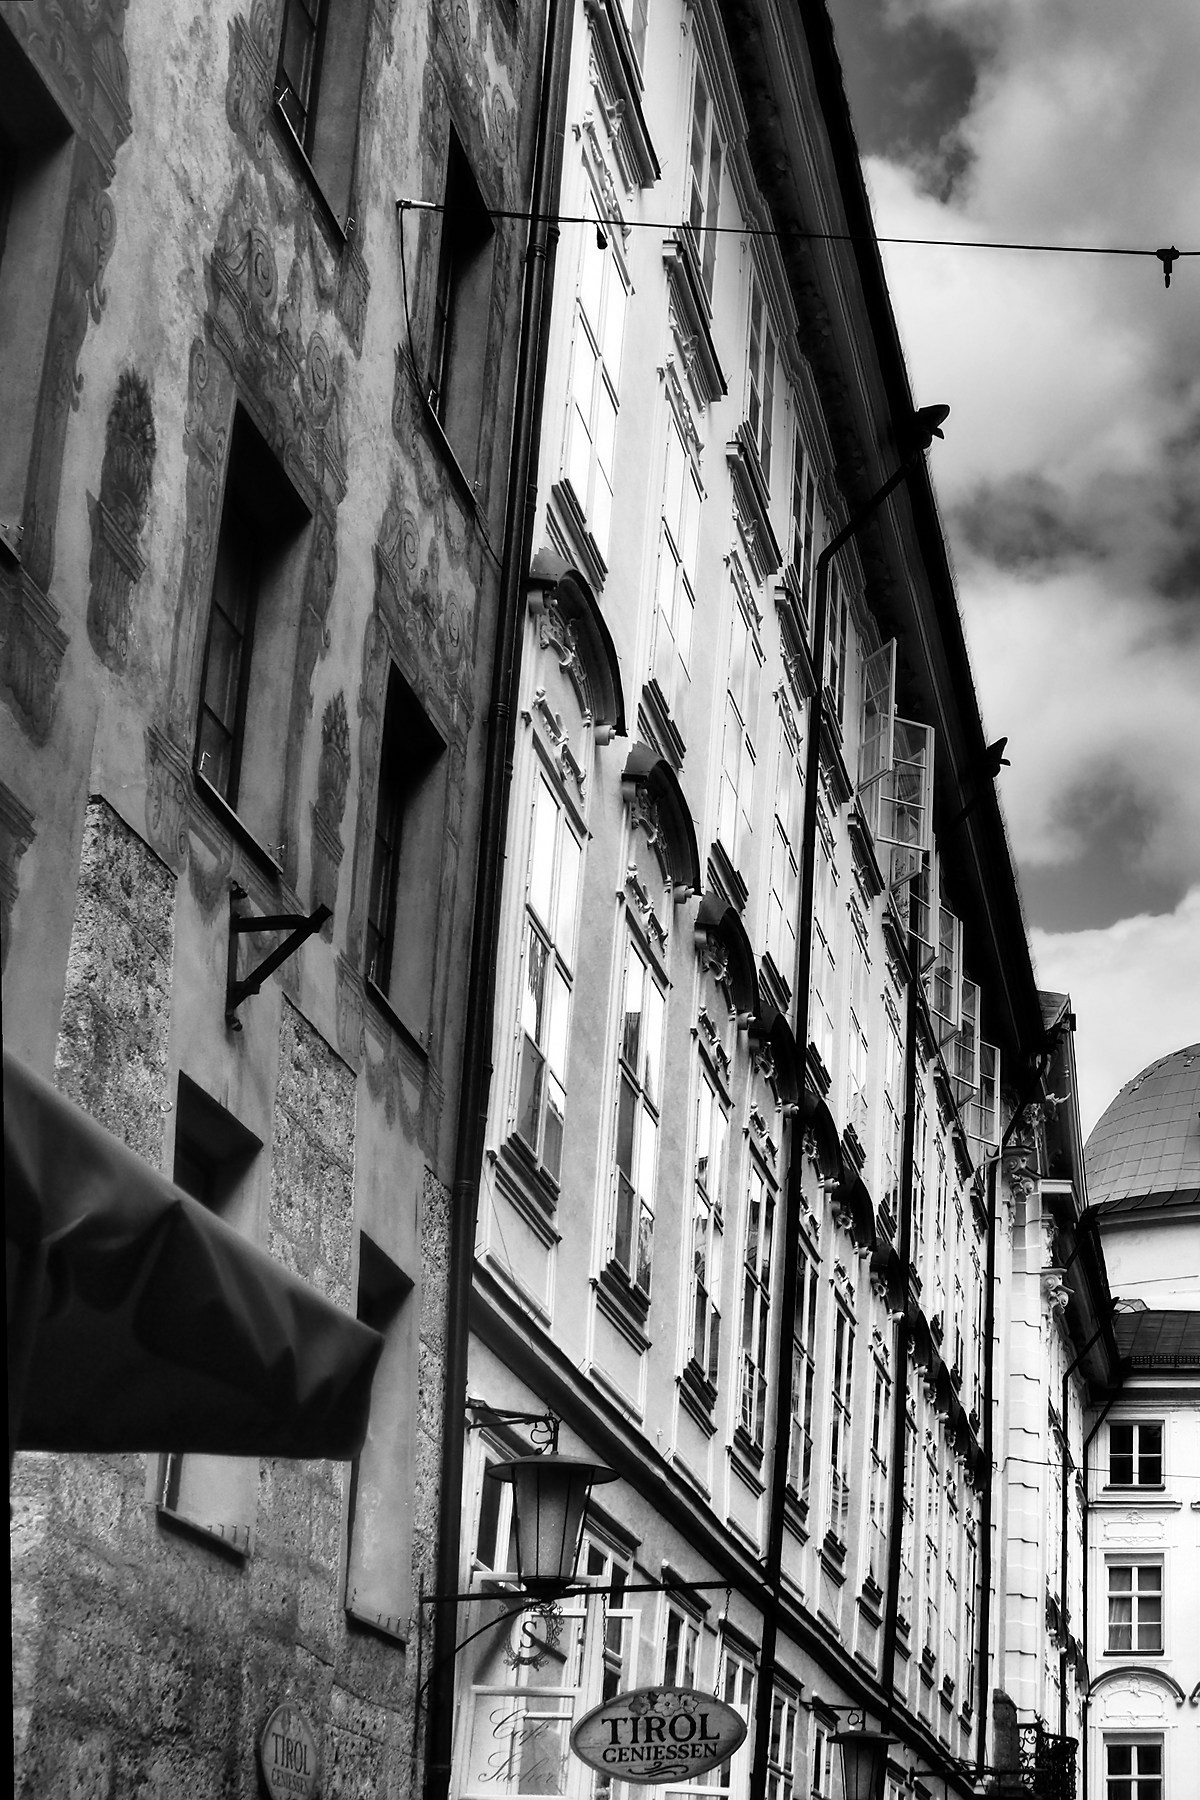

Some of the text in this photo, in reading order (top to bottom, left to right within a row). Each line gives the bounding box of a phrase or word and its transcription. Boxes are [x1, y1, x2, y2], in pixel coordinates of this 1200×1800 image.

[519, 1620, 538, 1649] S
[601, 1713, 720, 1745] TIROL
[271, 1732, 311, 1776] TIROL
[602, 1743, 718, 1763] GENIESSEN
